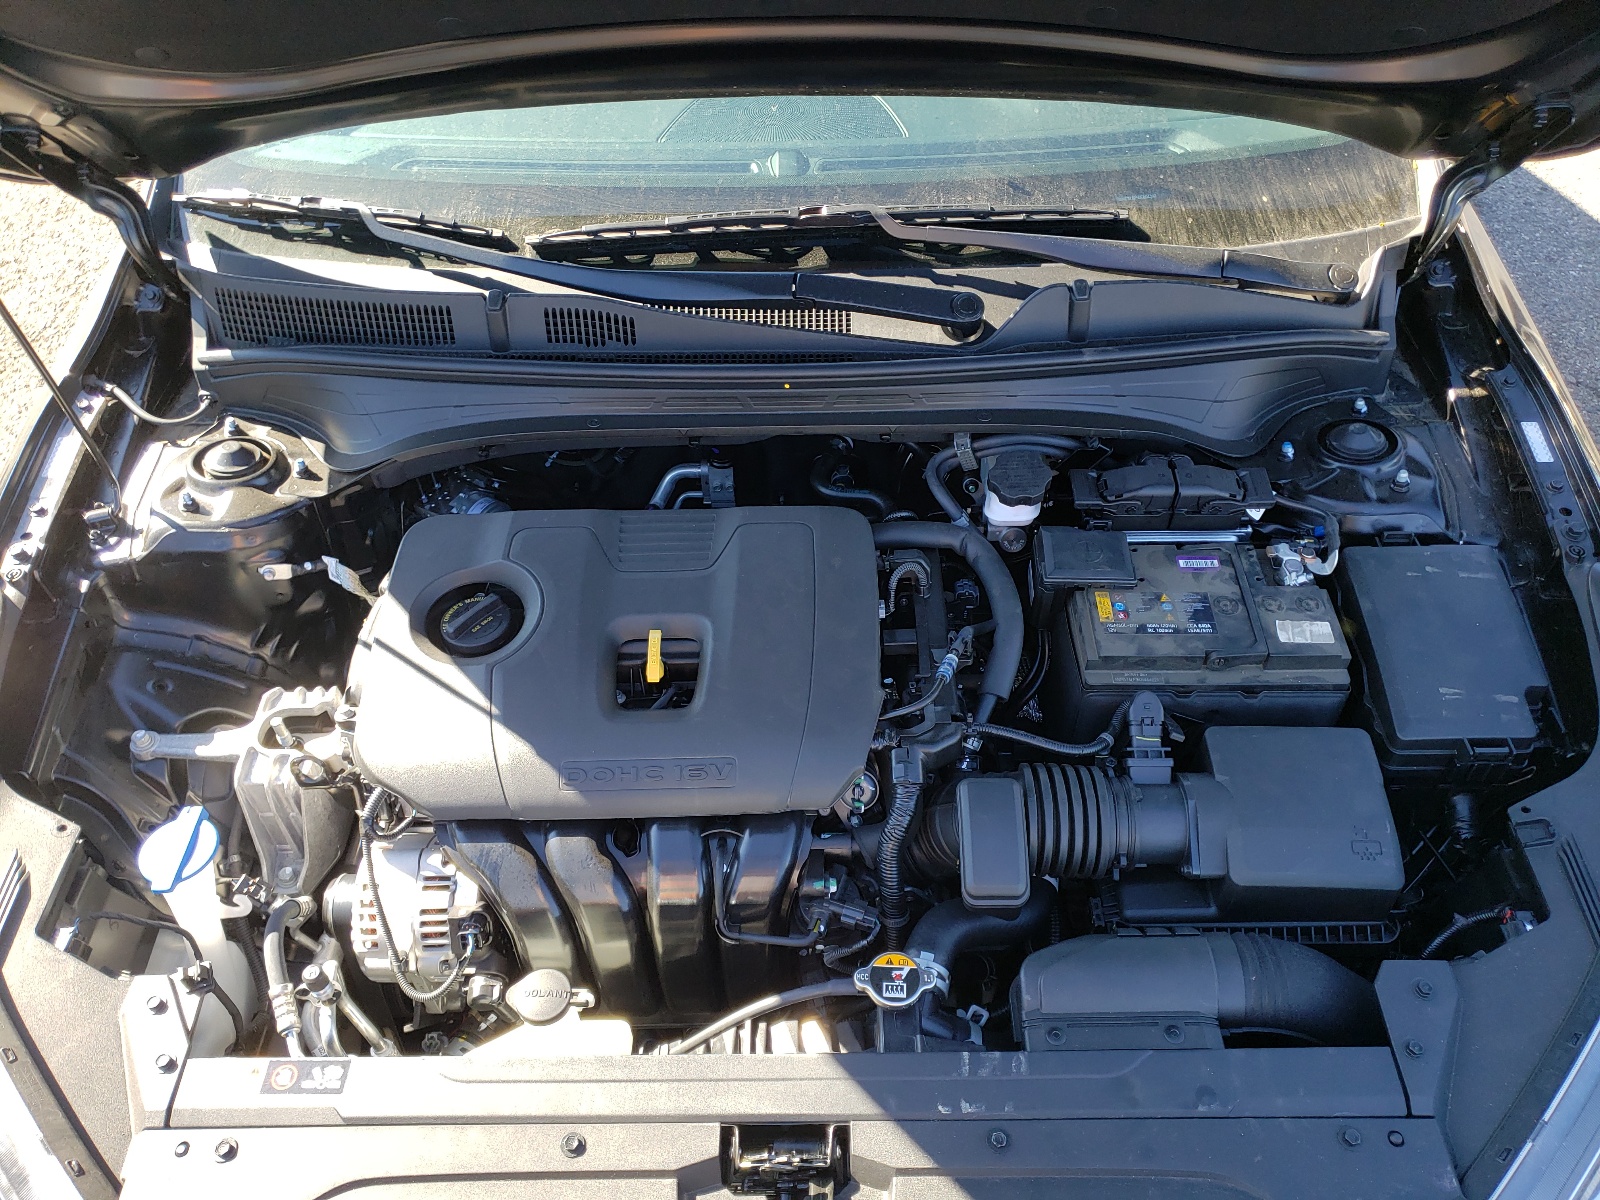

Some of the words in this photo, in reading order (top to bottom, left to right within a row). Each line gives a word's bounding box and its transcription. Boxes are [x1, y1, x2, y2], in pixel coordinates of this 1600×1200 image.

[562, 764, 665, 785] DOHC
[673, 762, 733, 782] 16V
[924, 974, 933, 982] 1.1
